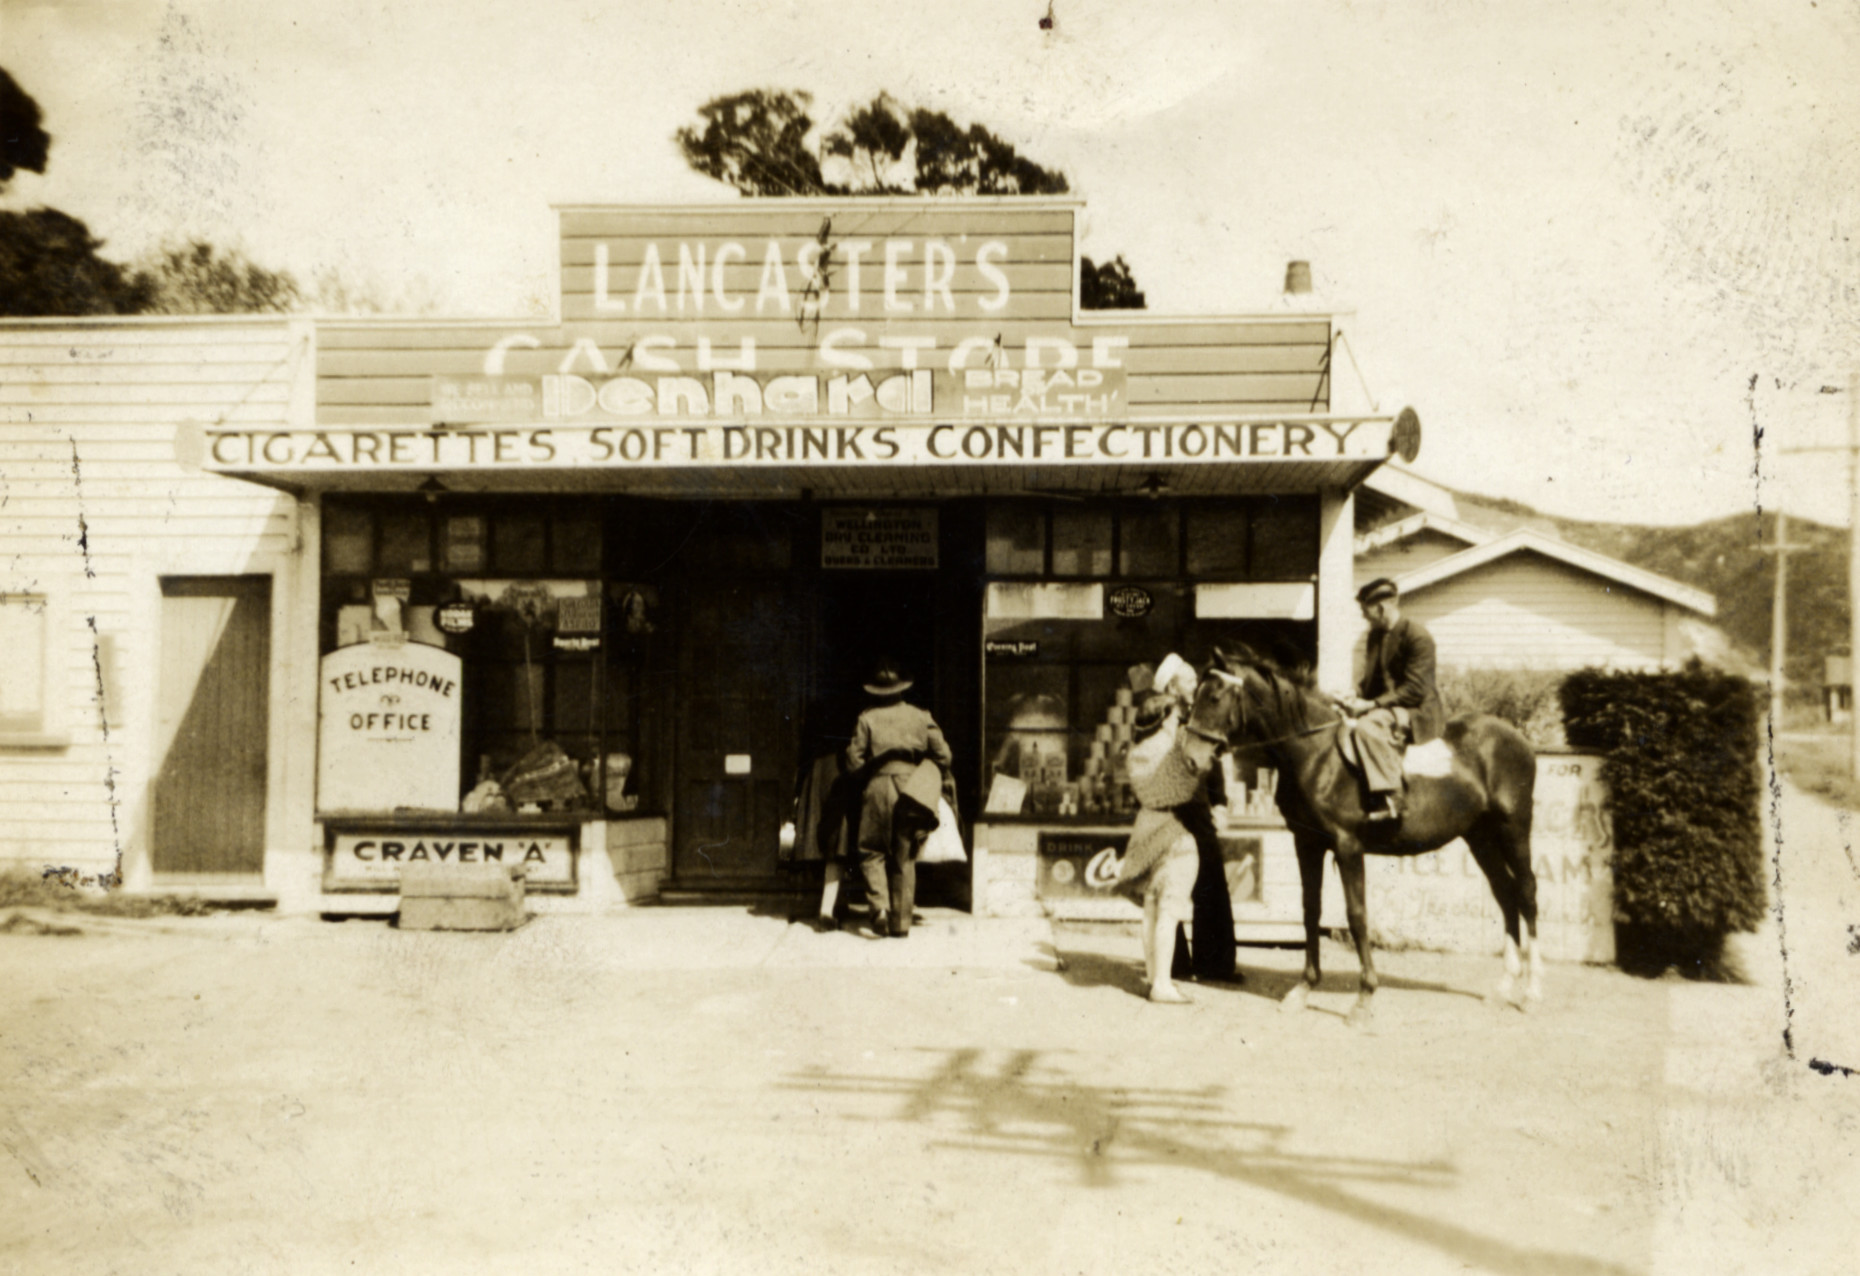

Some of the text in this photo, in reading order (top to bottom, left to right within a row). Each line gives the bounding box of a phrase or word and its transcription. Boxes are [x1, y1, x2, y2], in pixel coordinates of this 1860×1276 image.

[594, 235, 1011, 313] LANCASTER'S
[483, 333, 757, 375] CASH
[541, 369, 934, 416] Denhard
[965, 369, 1103, 390] BREAD
[589, 426, 708, 461] SOFT
[857, 532, 931, 544] CLEANING
[329, 666, 456, 698] TELEPHONE
[350, 712, 431, 731] OFFICE
[1548, 763, 1583, 777] FOR
[353, 840, 503, 863] CRAVEN
